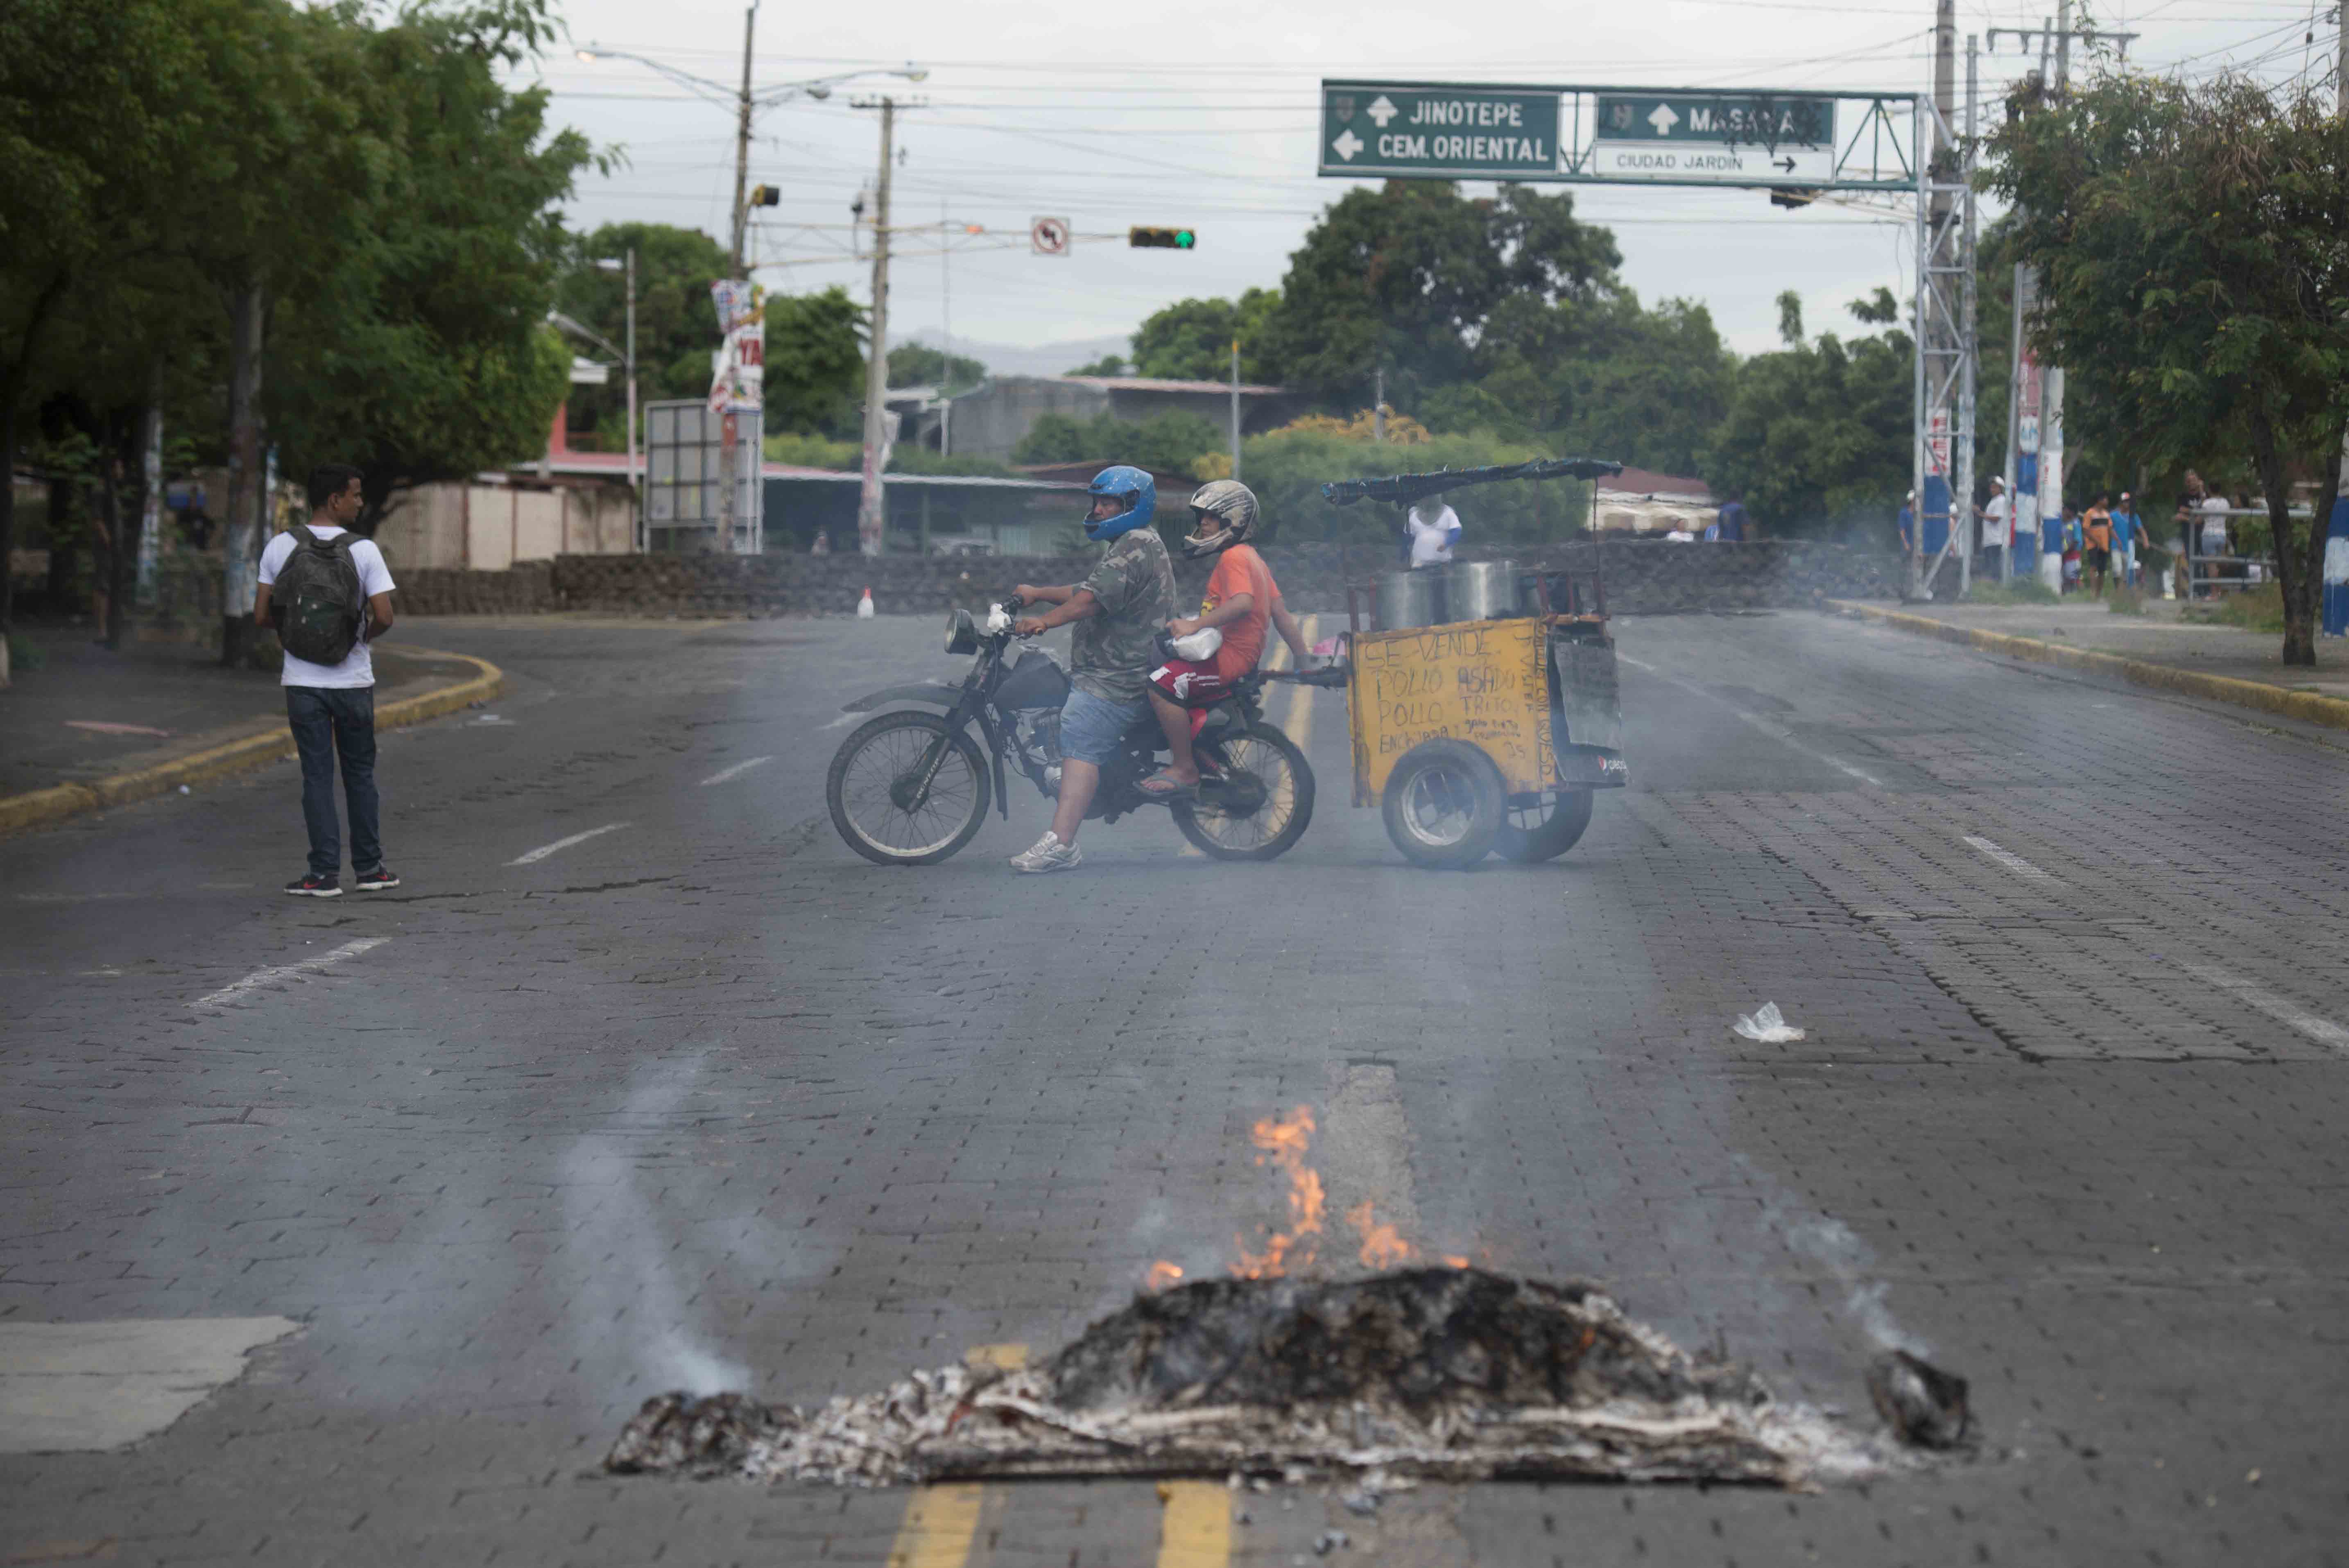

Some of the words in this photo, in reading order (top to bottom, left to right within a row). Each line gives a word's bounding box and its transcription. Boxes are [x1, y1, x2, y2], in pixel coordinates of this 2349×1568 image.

[1409, 100, 1523, 127] JINOTEPE
[1378, 134, 1430, 159] CEM.
[1434, 135, 1549, 161] ORIENTAL
[1617, 155, 1676, 169] CIUDAD
[1371, 667, 1442, 701] POLLO
[1458, 663, 1515, 693] ASADO
[1379, 699, 1444, 731] POLLO
[1537, 720, 1554, 775] QUESO
